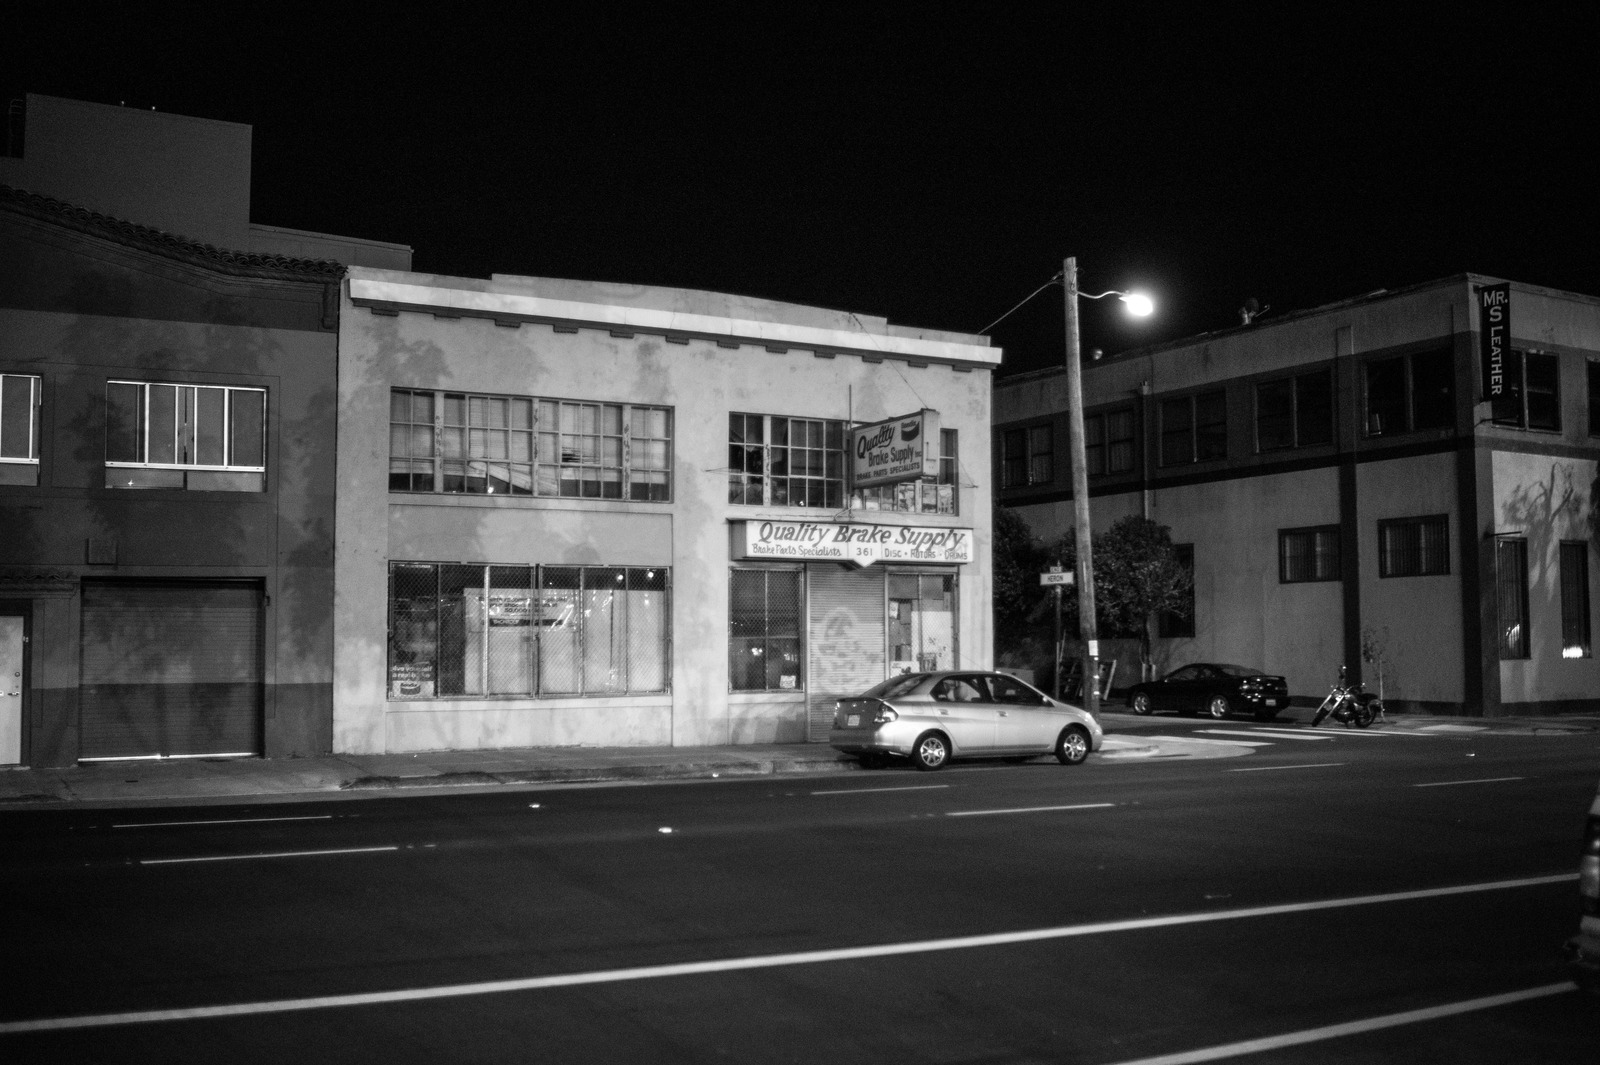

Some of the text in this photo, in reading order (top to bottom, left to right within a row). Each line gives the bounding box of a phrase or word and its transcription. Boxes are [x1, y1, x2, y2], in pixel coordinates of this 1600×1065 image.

[1484, 290, 1508, 307] MR.
[1489, 306, 1503, 322] S
[1491, 325, 1503, 395] LEATHER
[857, 425, 895, 459] Quality
[868, 450, 889, 468] Brake
[890, 444, 914, 465] Supply
[856, 462, 920, 480] BRAKE PARTS SPECIALISTS
[758, 522, 965, 551] Quality Brake Supply
[752, 543, 842, 557] Brake Parts Specialists
[856, 547, 873, 556] 361
[910, 549, 936, 559] ROTORS
[944, 549, 968, 560] DRUMS
